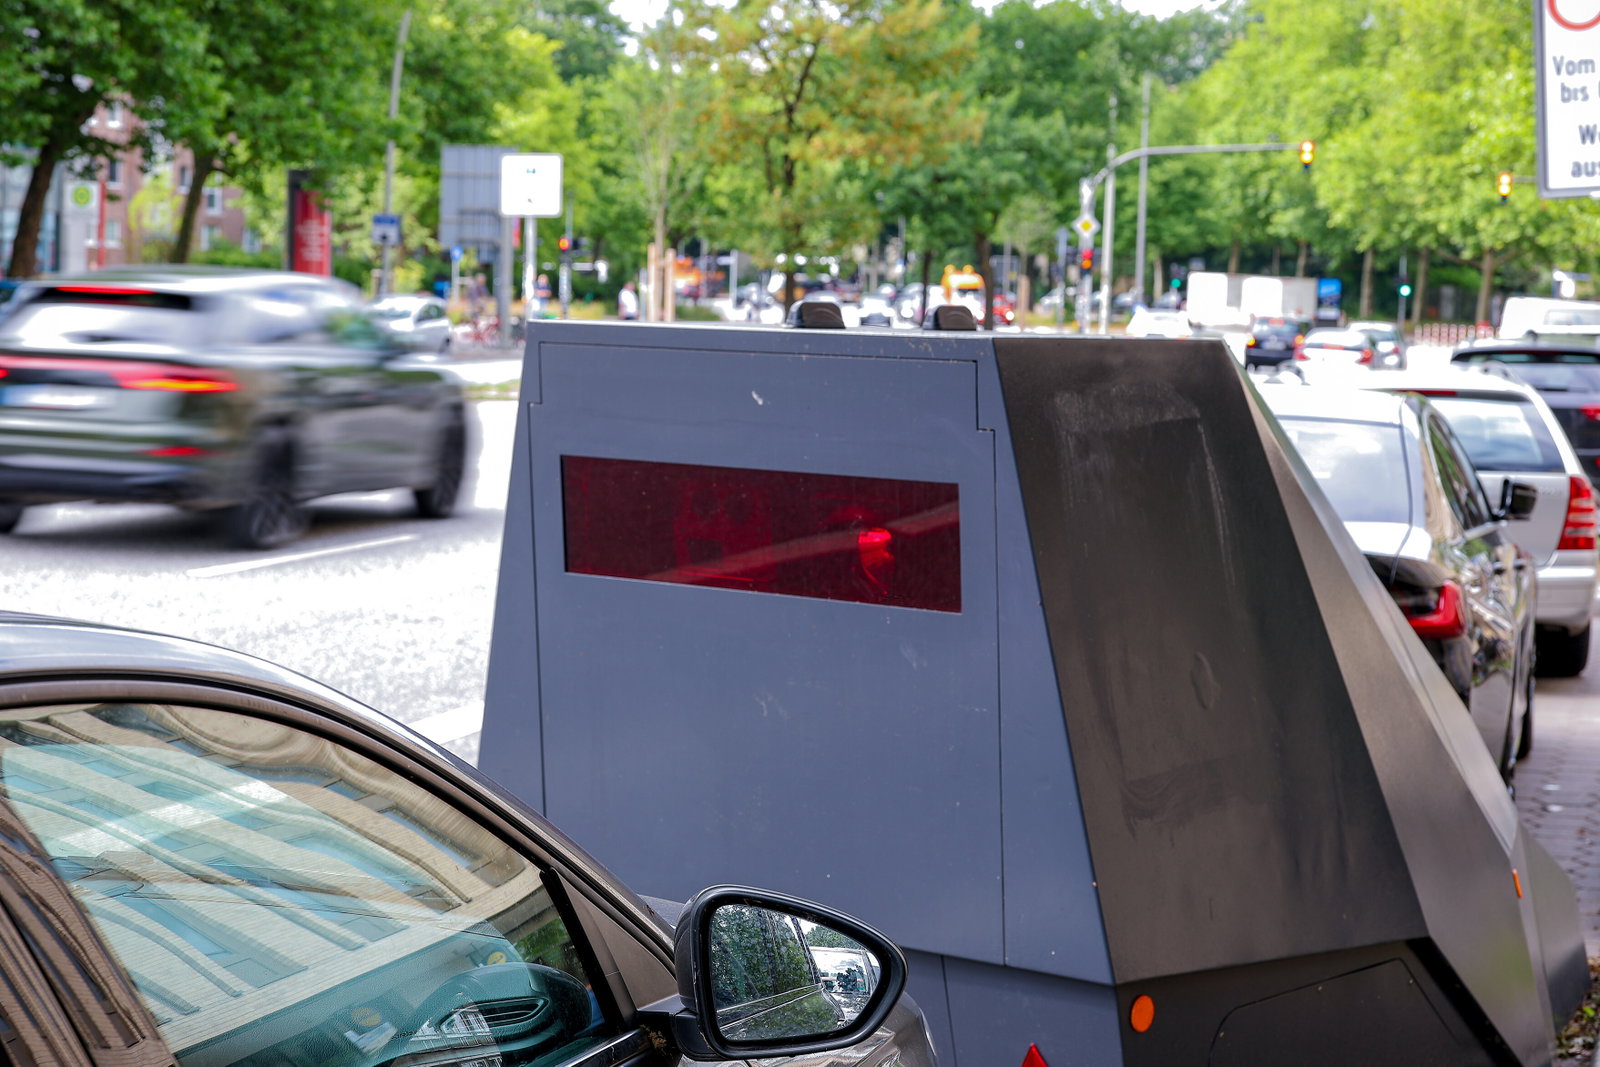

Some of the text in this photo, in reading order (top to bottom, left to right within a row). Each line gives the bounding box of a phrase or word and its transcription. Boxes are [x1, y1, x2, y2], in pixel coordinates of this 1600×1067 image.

[1553, 55, 1595, 76] Vom
[1560, 82, 1589, 103] bis
[1578, 123, 1600, 145] W
[1571, 161, 1600, 178] au
